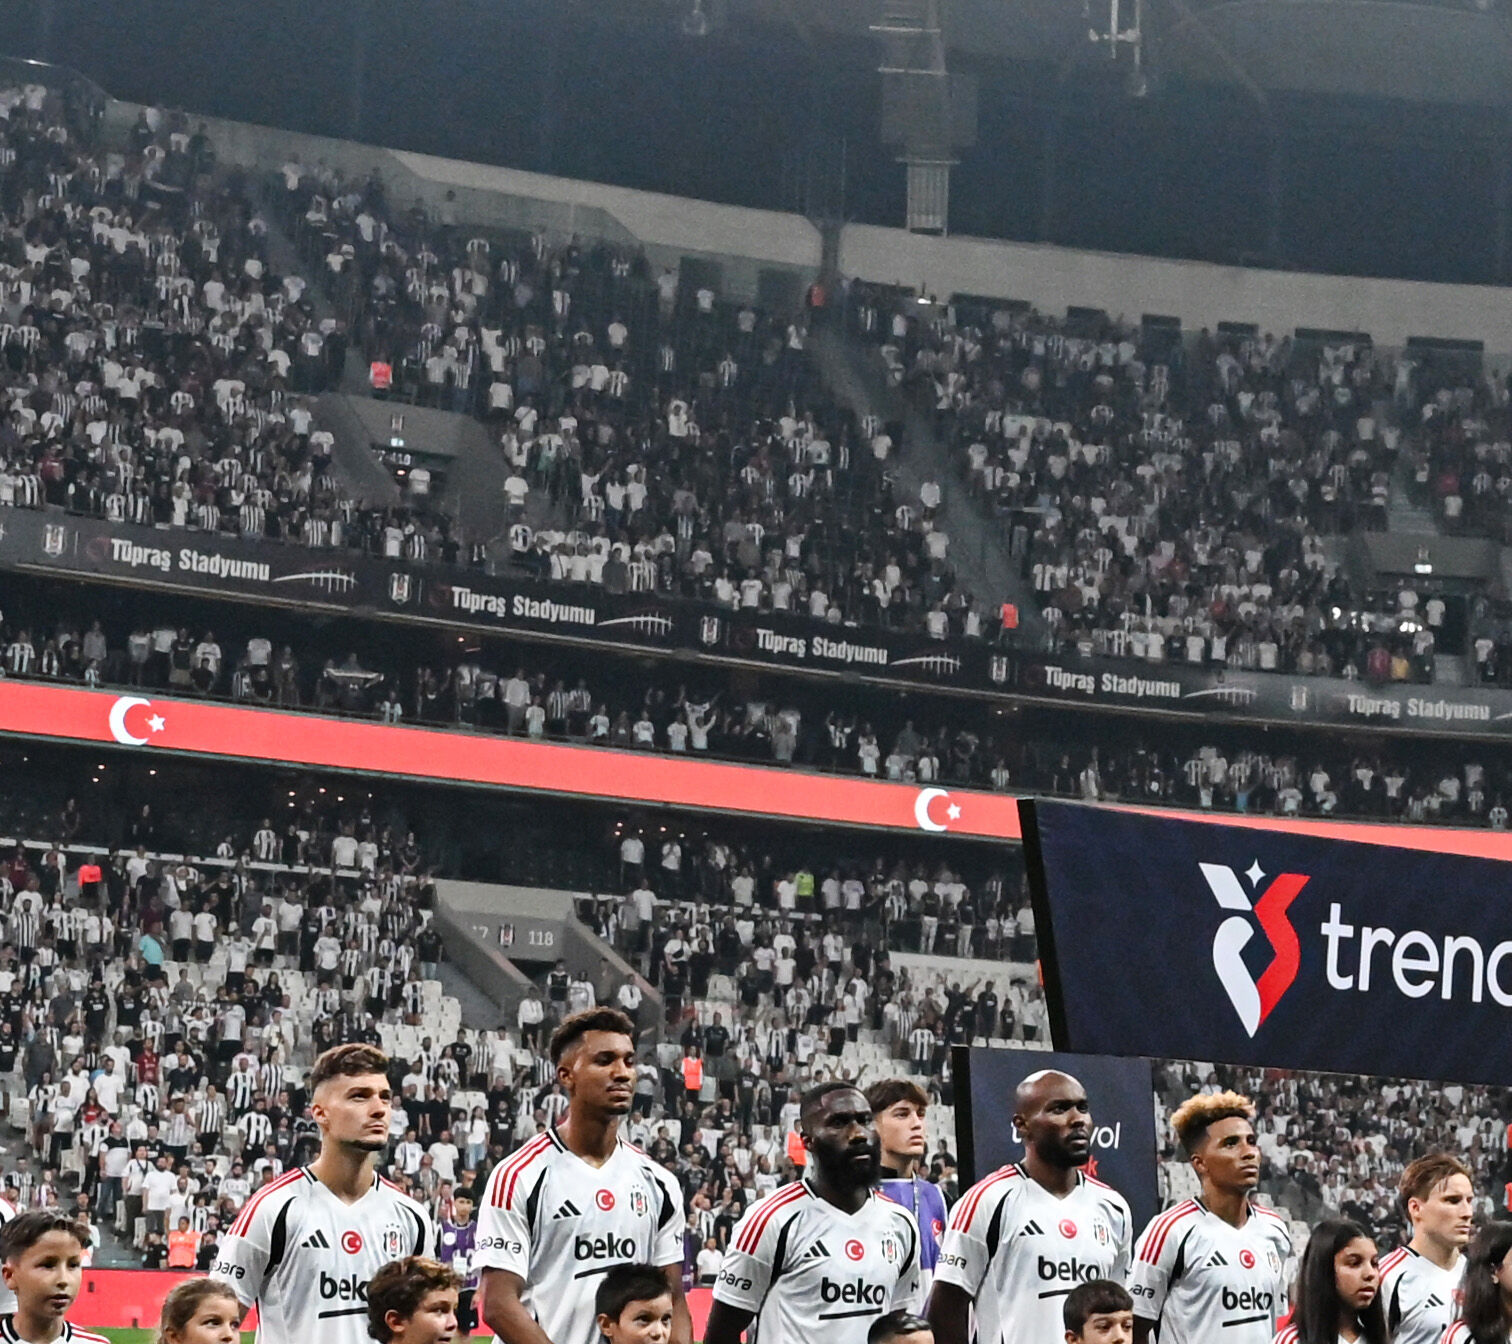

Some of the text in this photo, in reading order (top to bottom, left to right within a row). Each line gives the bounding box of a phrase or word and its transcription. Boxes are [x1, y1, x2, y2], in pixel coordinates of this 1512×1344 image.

[112, 538, 270, 581] Tüpraş Stadyumu
[452, 586, 595, 625] Tüpraş Stadyumu
[756, 628, 887, 665] Tüpraş Stadyumu
[1044, 665, 1180, 698] Tüpraş Stadyumu
[1347, 694, 1490, 720] Tüpraş Stadyumu
[527, 931, 554, 946] 118
[574, 1232, 636, 1261] beko
[1037, 1255, 1100, 1283] beko
[319, 1271, 368, 1302] bek
[820, 1276, 886, 1306] beko
[1222, 1286, 1273, 1311] beko
